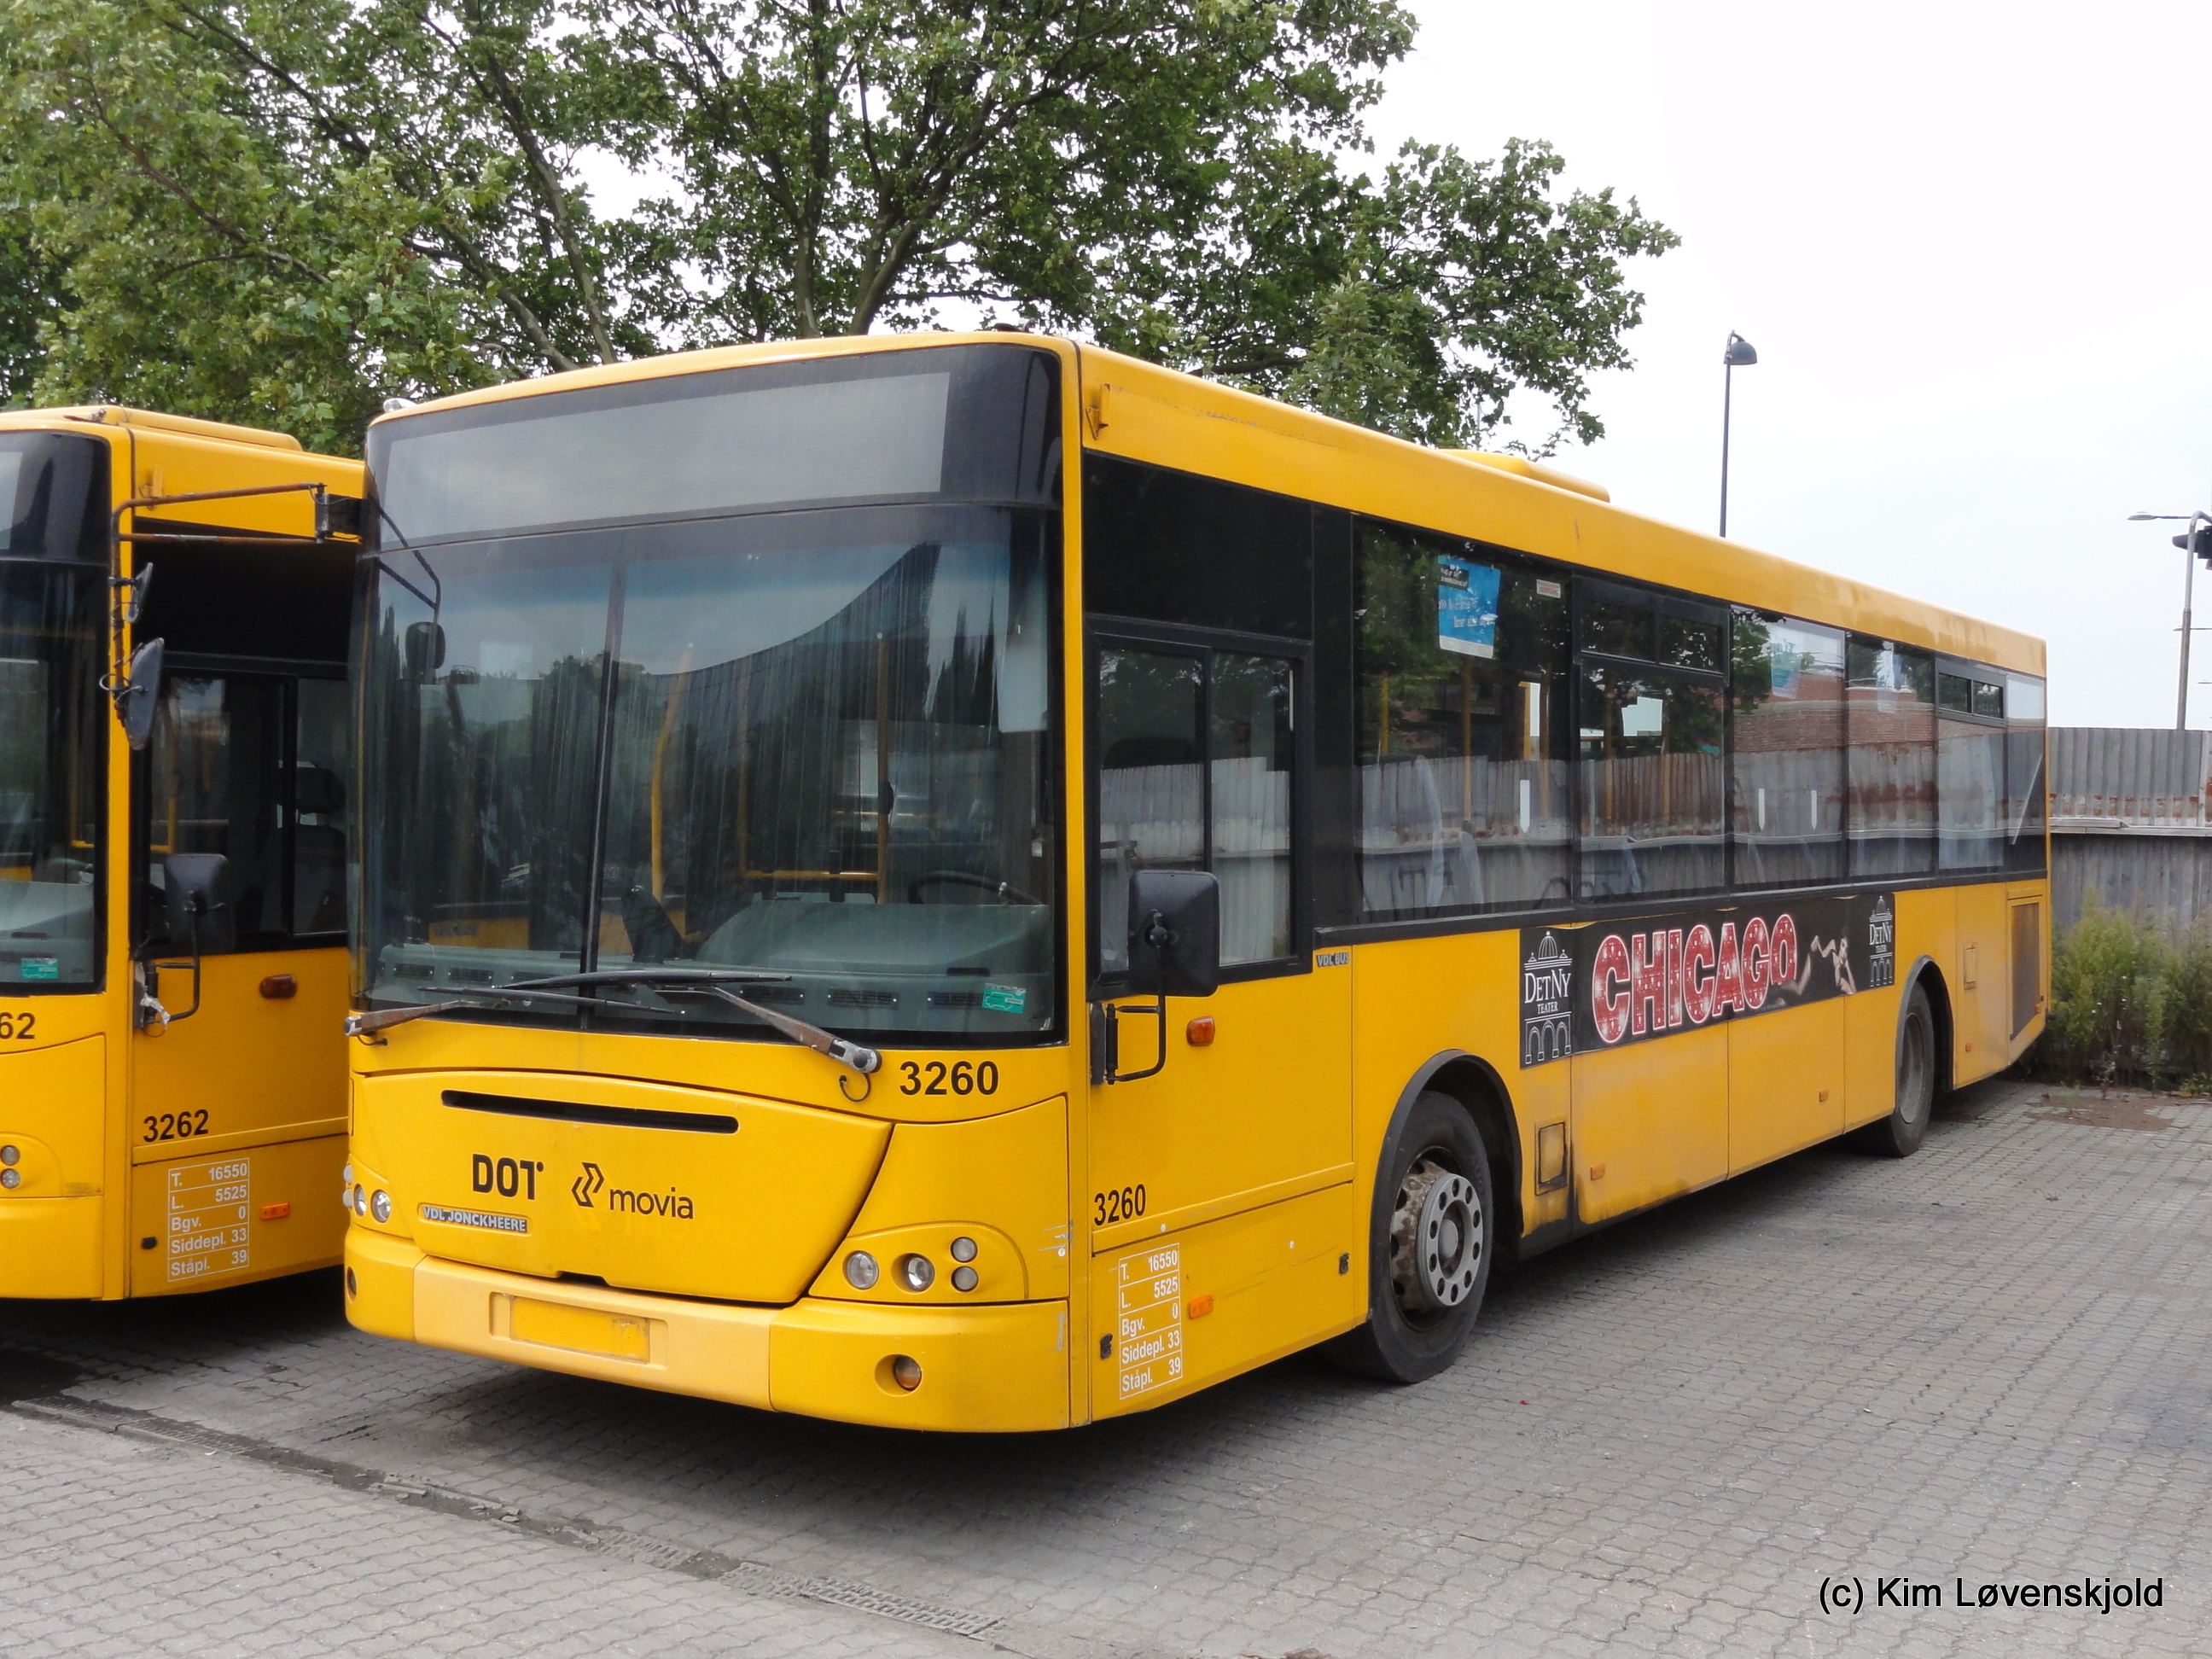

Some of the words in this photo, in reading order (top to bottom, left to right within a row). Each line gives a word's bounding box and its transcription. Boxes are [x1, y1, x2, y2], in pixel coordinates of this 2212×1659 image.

[1317, 953, 1334, 967] VDL
[1335, 952, 1350, 966] BUS
[1592, 914, 1797, 1044] CHICAGO
[1537, 1001, 1558, 1015] TEATER
[899, 1060, 999, 1096] 3260
[143, 1109, 209, 1143] 3262
[171, 1173, 183, 1187] T.
[207, 1163, 247, 1182] 16550
[472, 1153, 536, 1200] DOT
[171, 1195, 184, 1210] L.
[214, 1185, 247, 1203] 5525
[609, 1186, 695, 1220] movia
[1093, 1183, 1147, 1226] 3260
[171, 1215, 202, 1233] Bgv.
[237, 1205, 247, 1220] 0
[422, 1205, 445, 1221] VDL
[448, 1210, 527, 1232] JONCKHEERE
[171, 1234, 227, 1254] Siddepl.
[230, 1228, 247, 1243] 33
[171, 1258, 211, 1277] Ståpl.
[230, 1249, 247, 1265] 39
[1121, 1264, 1130, 1281] T.
[1148, 1250, 1179, 1272] 16550
[1121, 1291, 1132, 1310] L.
[1153, 1275, 1179, 1299] 5525
[1121, 1318, 1145, 1338] Bgv.
[1171, 1303, 1179, 1319] 0
[1121, 1339, 1165, 1365] Siddepl.
[1167, 1330, 1181, 1349] 33
[1121, 1368, 1154, 1394] Ståpl.
[1167, 1358, 1182, 1377] 39
